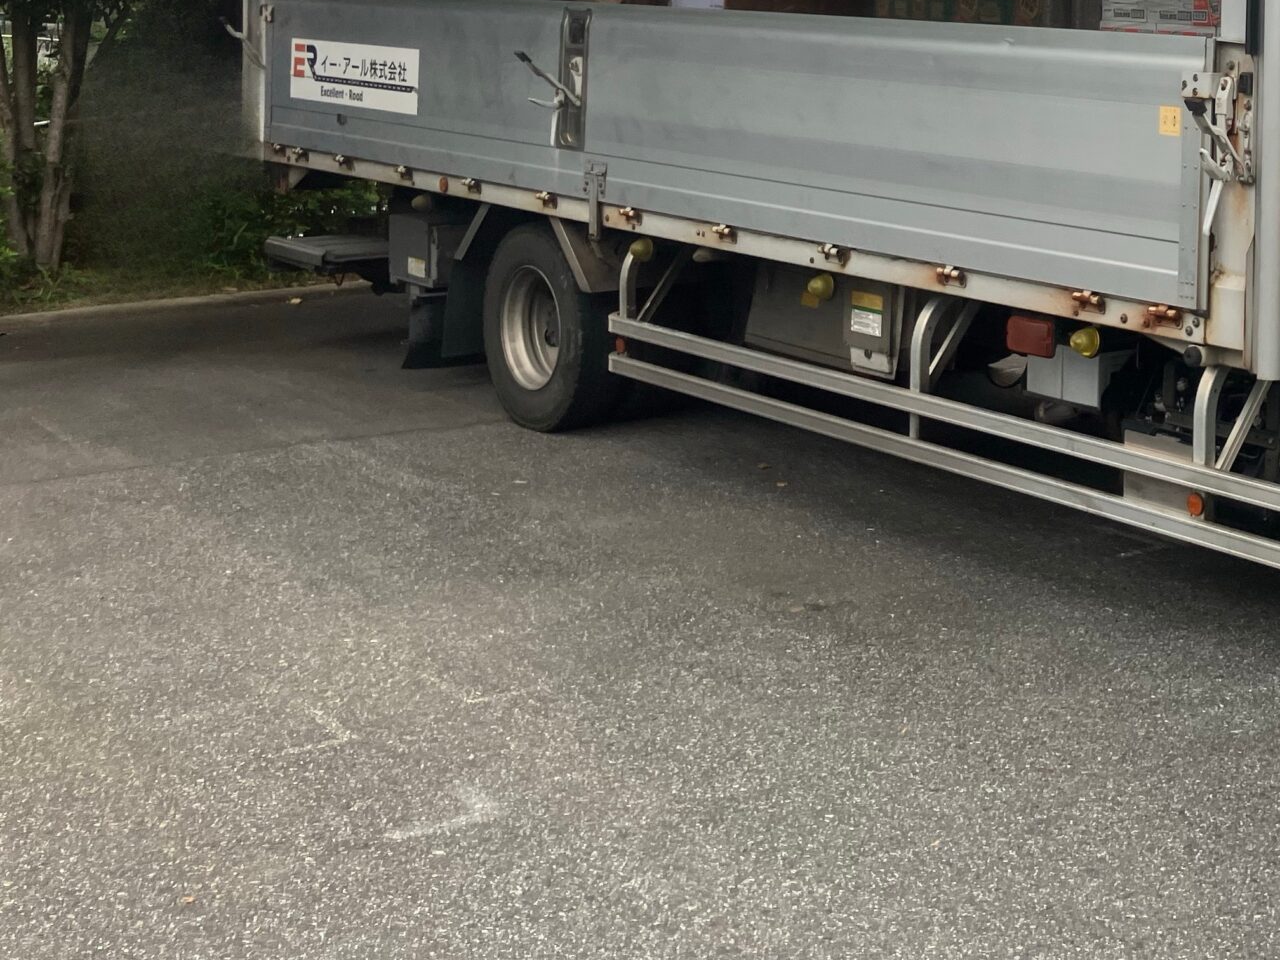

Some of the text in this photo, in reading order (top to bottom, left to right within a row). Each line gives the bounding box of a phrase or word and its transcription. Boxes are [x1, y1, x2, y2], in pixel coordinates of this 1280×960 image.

[321, 54, 408, 83] イー・アール株式会社
[320, 85, 364, 102] Excellent Road
